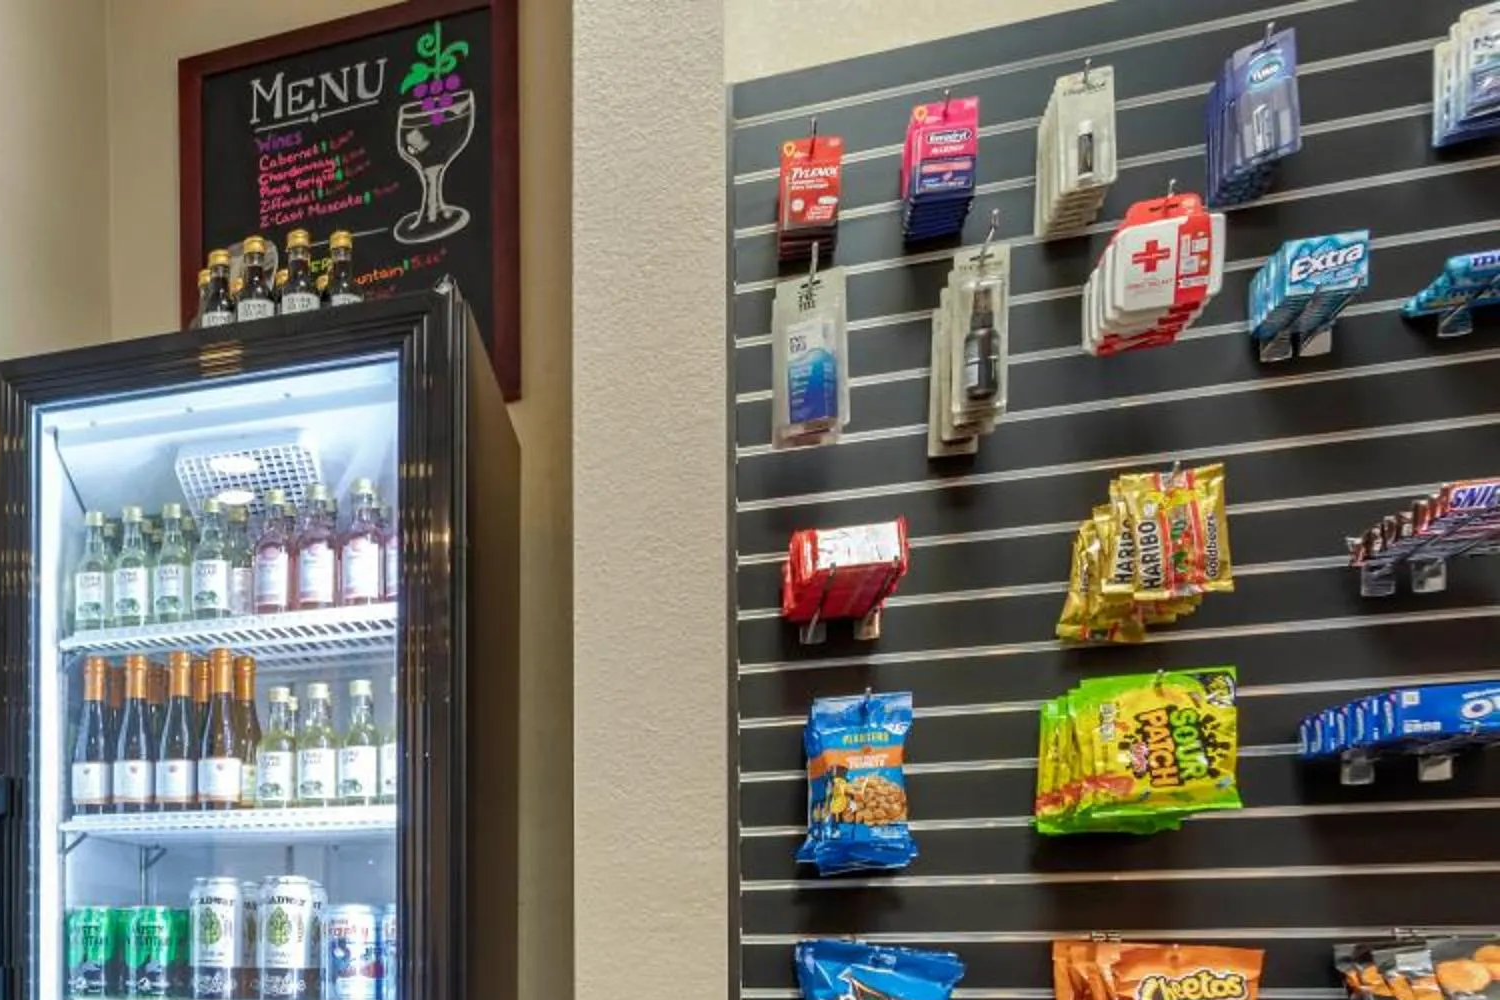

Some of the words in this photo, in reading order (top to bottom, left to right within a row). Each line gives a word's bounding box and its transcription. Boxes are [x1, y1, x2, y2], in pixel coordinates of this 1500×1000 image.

[354, 265, 405, 285] untain
[1291, 243, 1364, 282] Extra
[1138, 521, 1162, 589] HARIBO
[1137, 707, 1180, 786] PATCH
[1169, 707, 1209, 780] SOUR
